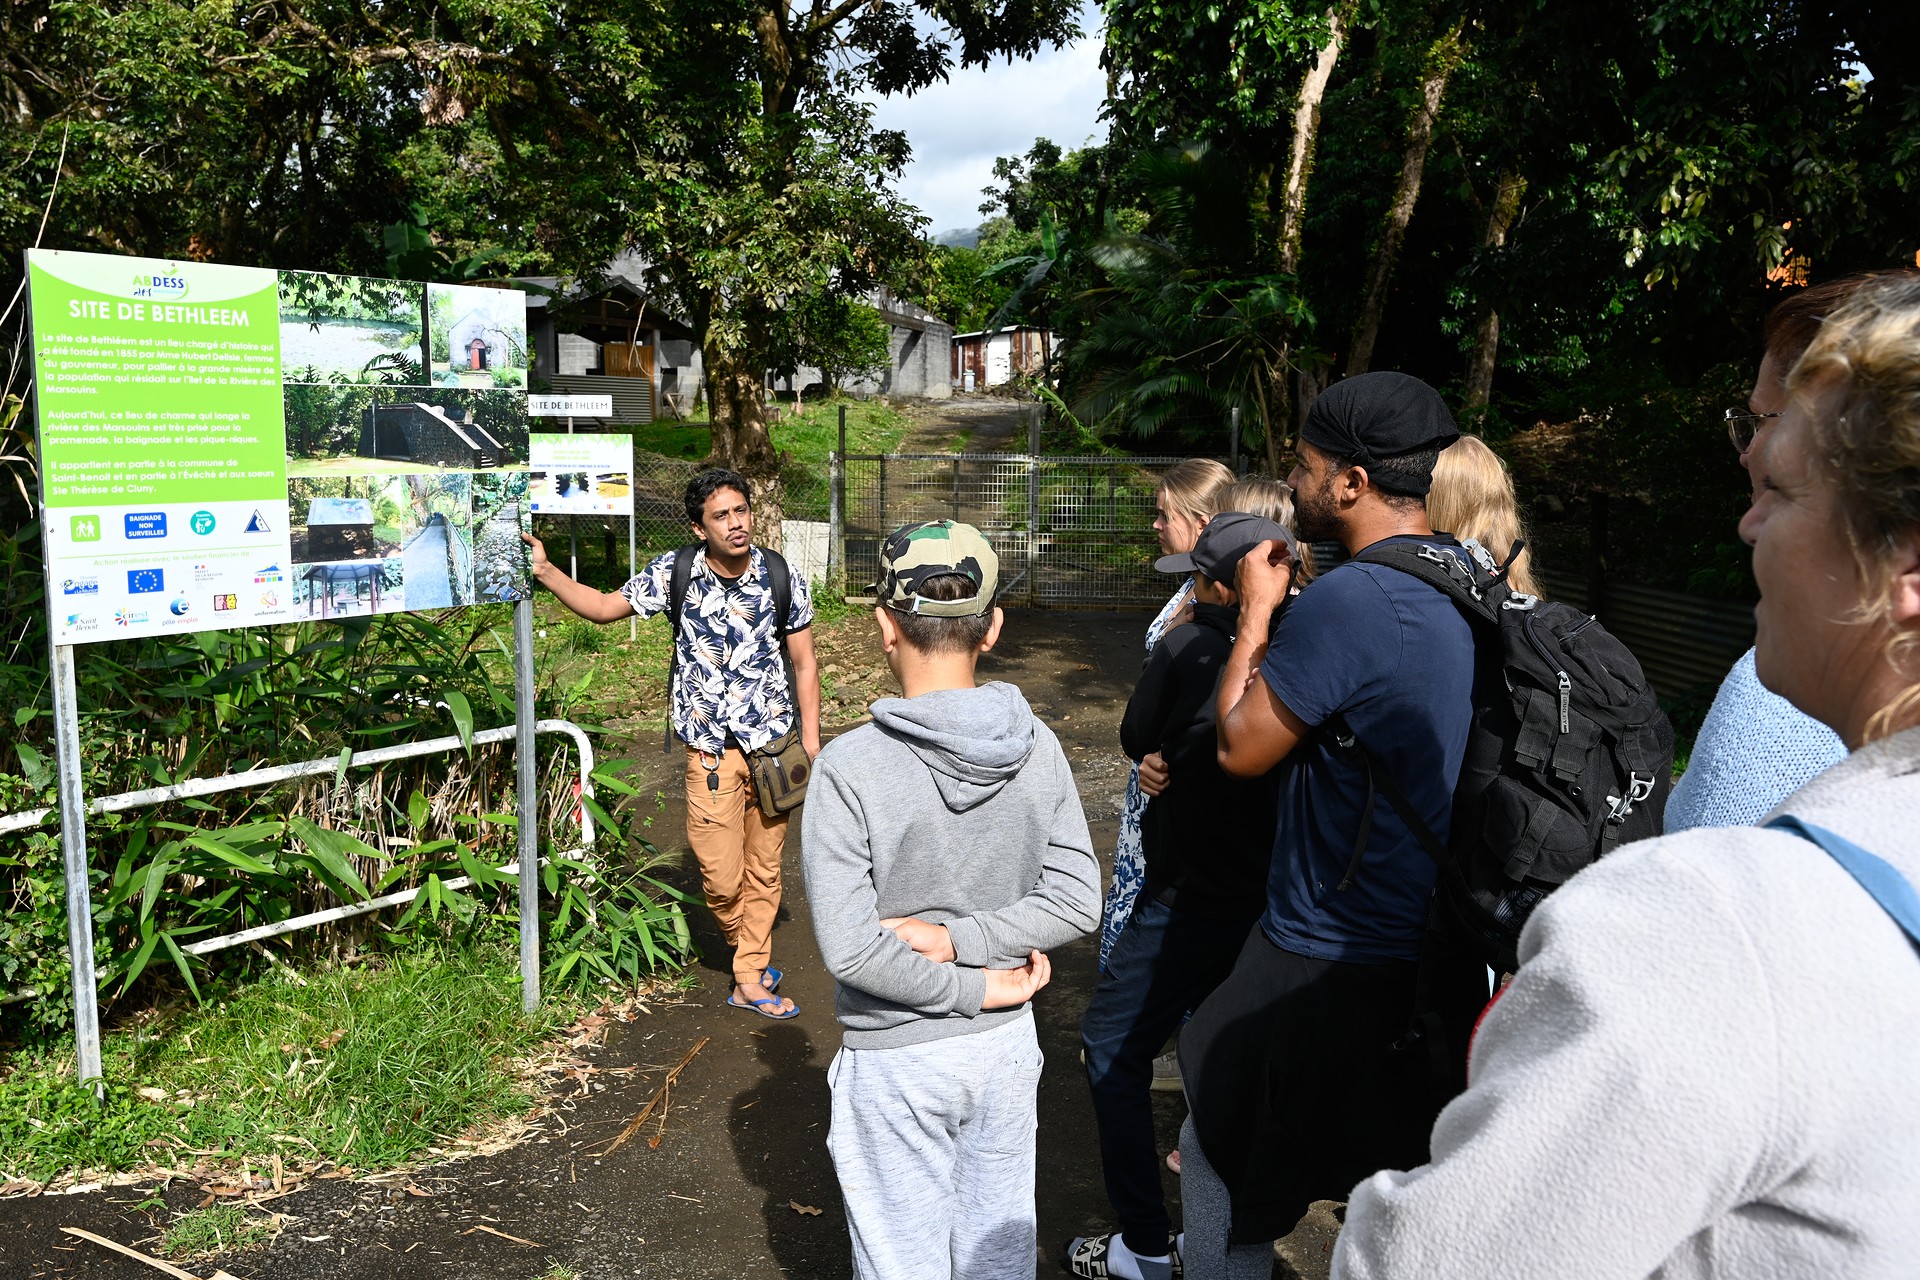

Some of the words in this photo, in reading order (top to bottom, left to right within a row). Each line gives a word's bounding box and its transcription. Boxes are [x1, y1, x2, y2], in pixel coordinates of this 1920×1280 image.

[132, 275, 185, 289] ABDESS
[69, 299, 110, 319] SITE
[118, 303, 144, 321] DE
[152, 305, 249, 326] BETHLEEM
[43, 333, 54, 342] Le
[56, 334, 73, 342] site
[75, 335, 89, 343] de
[139, 338, 154, 346] est
[168, 339, 186, 347] lieu
[186, 340, 218, 350] chargé
[220, 342, 259, 350] d'histoire
[260, 344, 274, 352] qui
[44, 348, 50, 356] a
[52, 346, 69, 355] été
[69, 347, 99, 356] fondé
[116, 349, 138, 358] 1855
[156, 351, 180, 359] Mme
[182, 352, 212, 360] Hubert
[244, 354, 274, 362] femme
[44, 359, 58, 367] du
[123, 363, 145, 371] pour
[179, 363, 185, 371] à
[188, 364, 196, 372] la
[199, 365, 231, 374] grande
[233, 366, 261, 374] misère
[45, 372, 54, 380] la
[58, 373, 111, 382] population
[114, 374, 130, 383] qui
[132, 374, 166, 383] résidait
[230, 377, 258, 385] Rivière
[260, 378, 275, 386] des
[530, 402, 548, 410] SITE
[551, 402, 562, 410] DE
[564, 402, 608, 410] BETHLEEM
[126, 411, 142, 419] lieu
[160, 412, 196, 420] charme
[198, 412, 214, 421] qui
[214, 412, 240, 421] longe
[242, 412, 250, 420] la
[48, 423, 79, 432] rivière
[82, 423, 100, 432] des
[49, 436, 111, 446] promenade,
[114, 436, 123, 444] la
[126, 436, 172, 445] baignade
[51, 461, 56, 469] Il
[59, 461, 111, 470] appartient
[128, 460, 156, 470] partie
[158, 459, 165, 468] à
[178, 460, 224, 468] commune
[140, 472, 167, 481] partie
[170, 471, 176, 479] à
[52, 486, 68, 495] Ste
[70, 485, 108, 494] Thérèse
[111, 485, 124, 493] de
[127, 484, 156, 493] Cluny.
[162, 618, 175, 626] pôle
